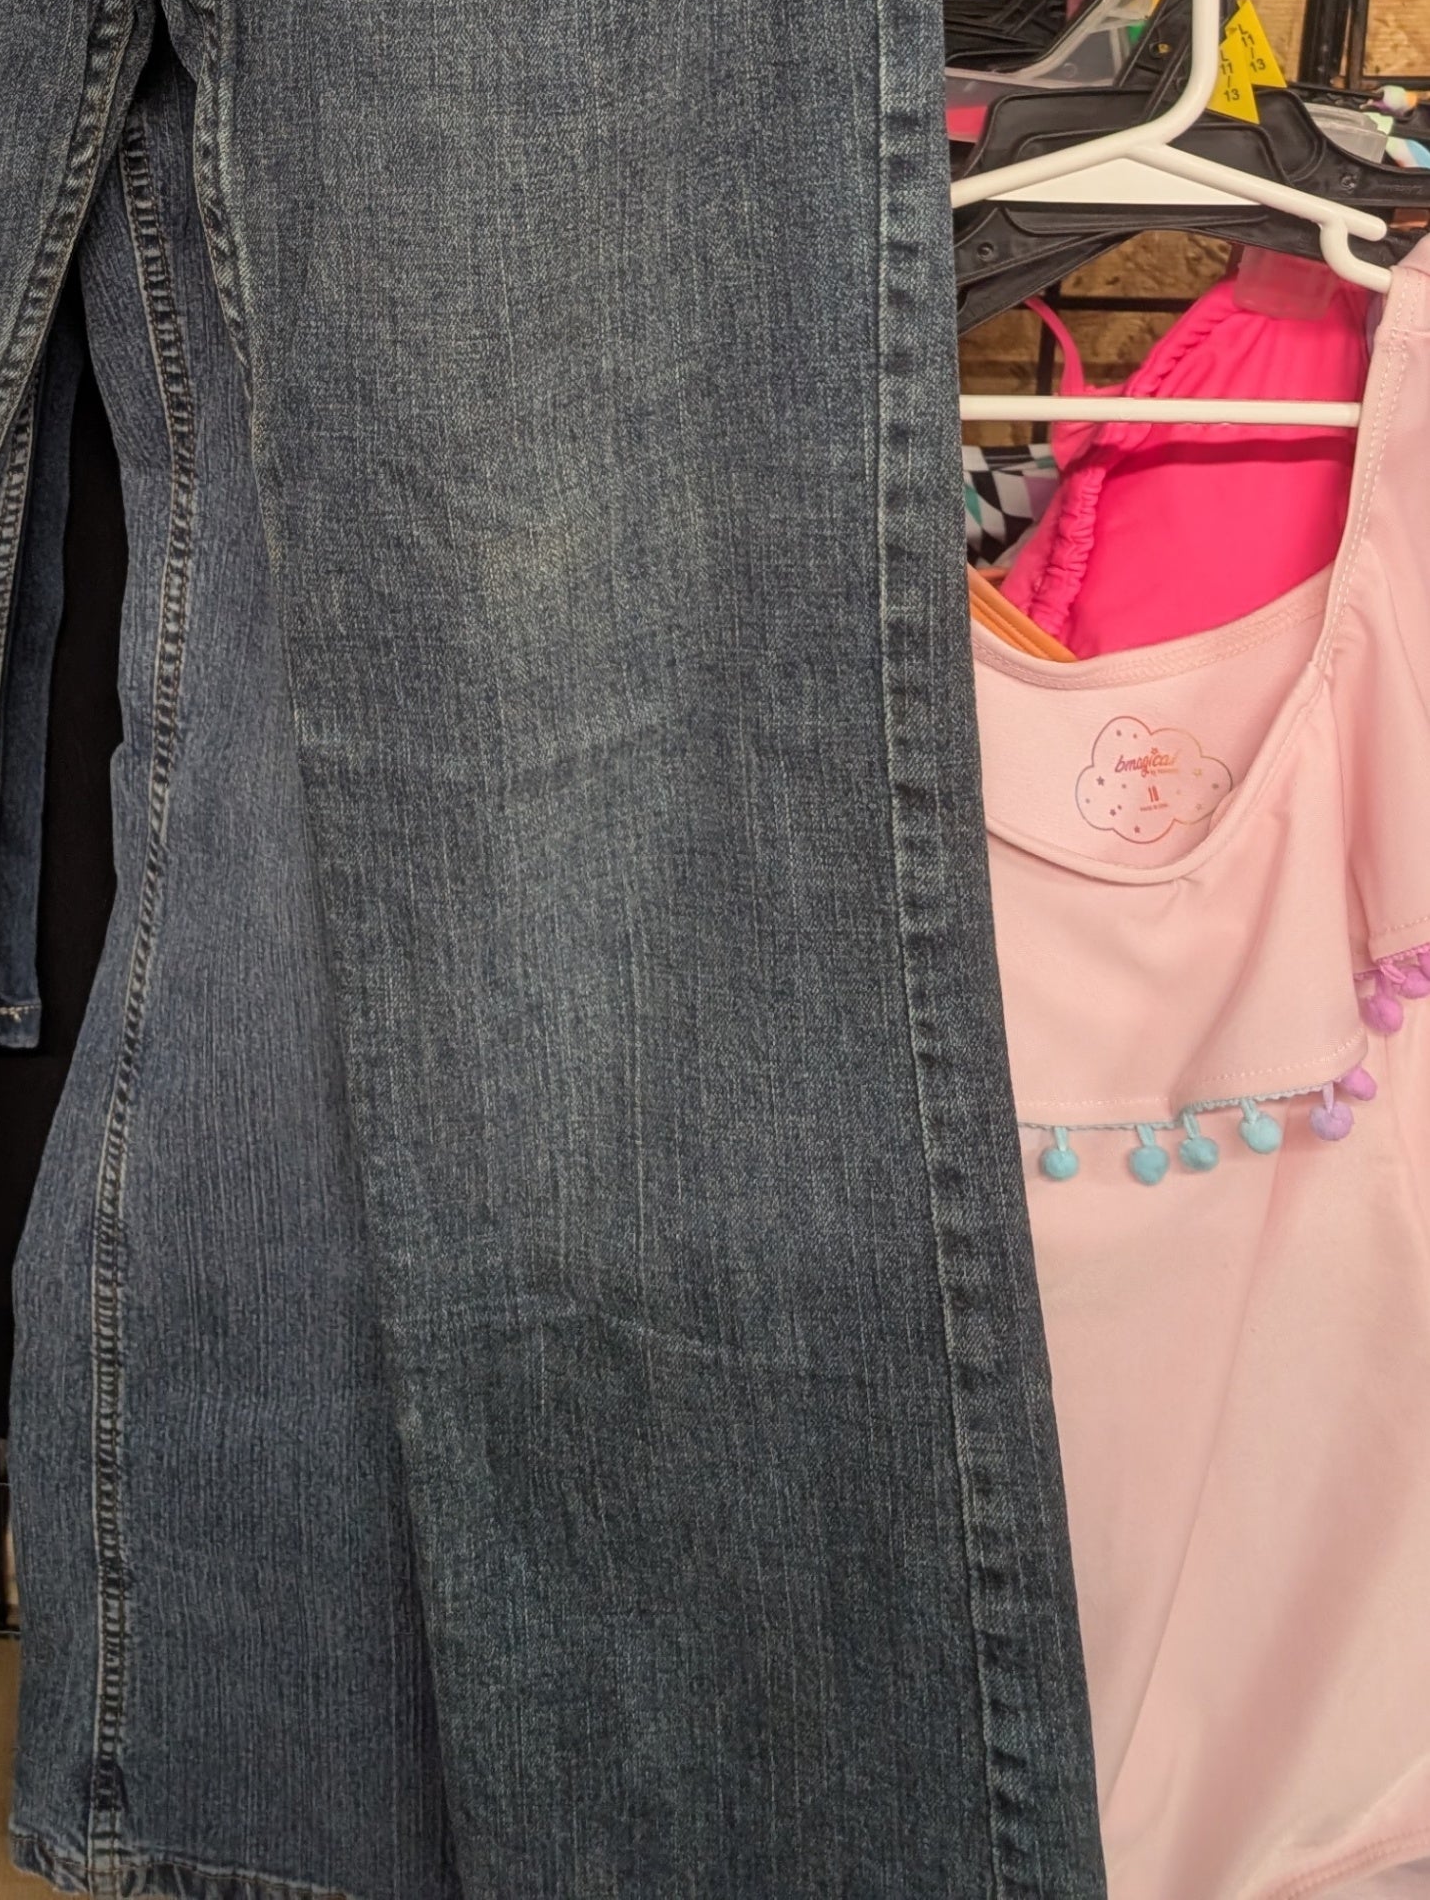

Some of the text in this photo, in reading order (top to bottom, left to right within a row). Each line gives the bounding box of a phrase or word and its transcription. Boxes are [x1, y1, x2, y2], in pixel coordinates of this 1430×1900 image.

[1238, 23, 1249, 35] L
[1241, 34, 1255, 47] 11
[1220, 49, 1229, 62] L
[1220, 62, 1233, 75] 11
[1250, 58, 1266, 72] 13
[1224, 88, 1240, 102] 13
